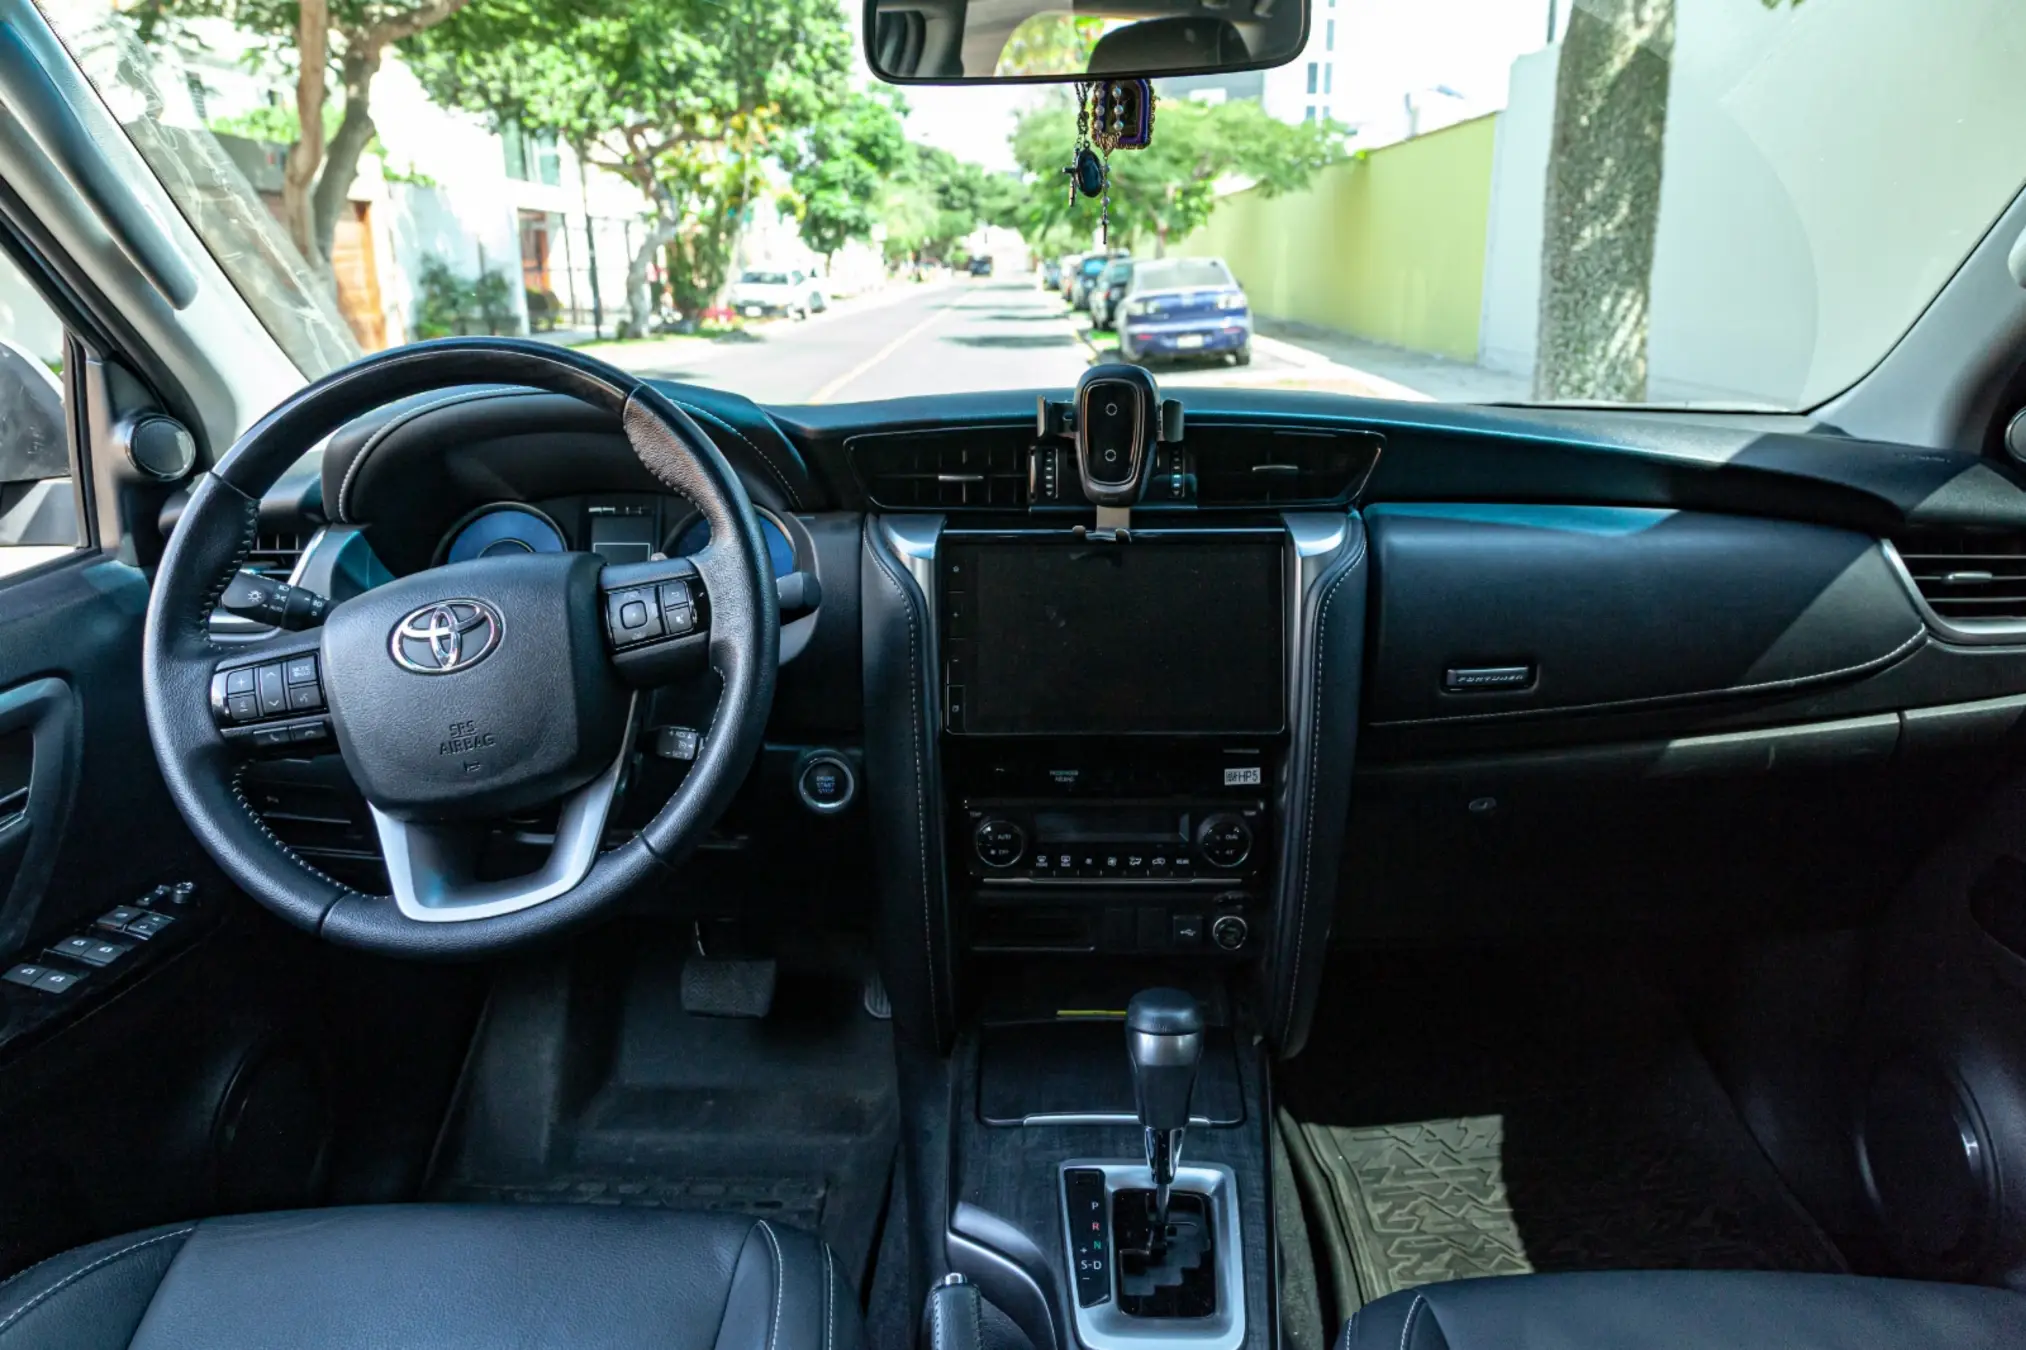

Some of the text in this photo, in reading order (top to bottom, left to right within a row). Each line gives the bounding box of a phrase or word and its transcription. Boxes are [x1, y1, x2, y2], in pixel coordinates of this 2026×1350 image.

[449, 720, 476, 737] SRS
[440, 733, 496, 755] AIRBAG
[1091, 1201, 1099, 1210] P
[1091, 1221, 1100, 1231] R
[1093, 1240, 1102, 1250] N
